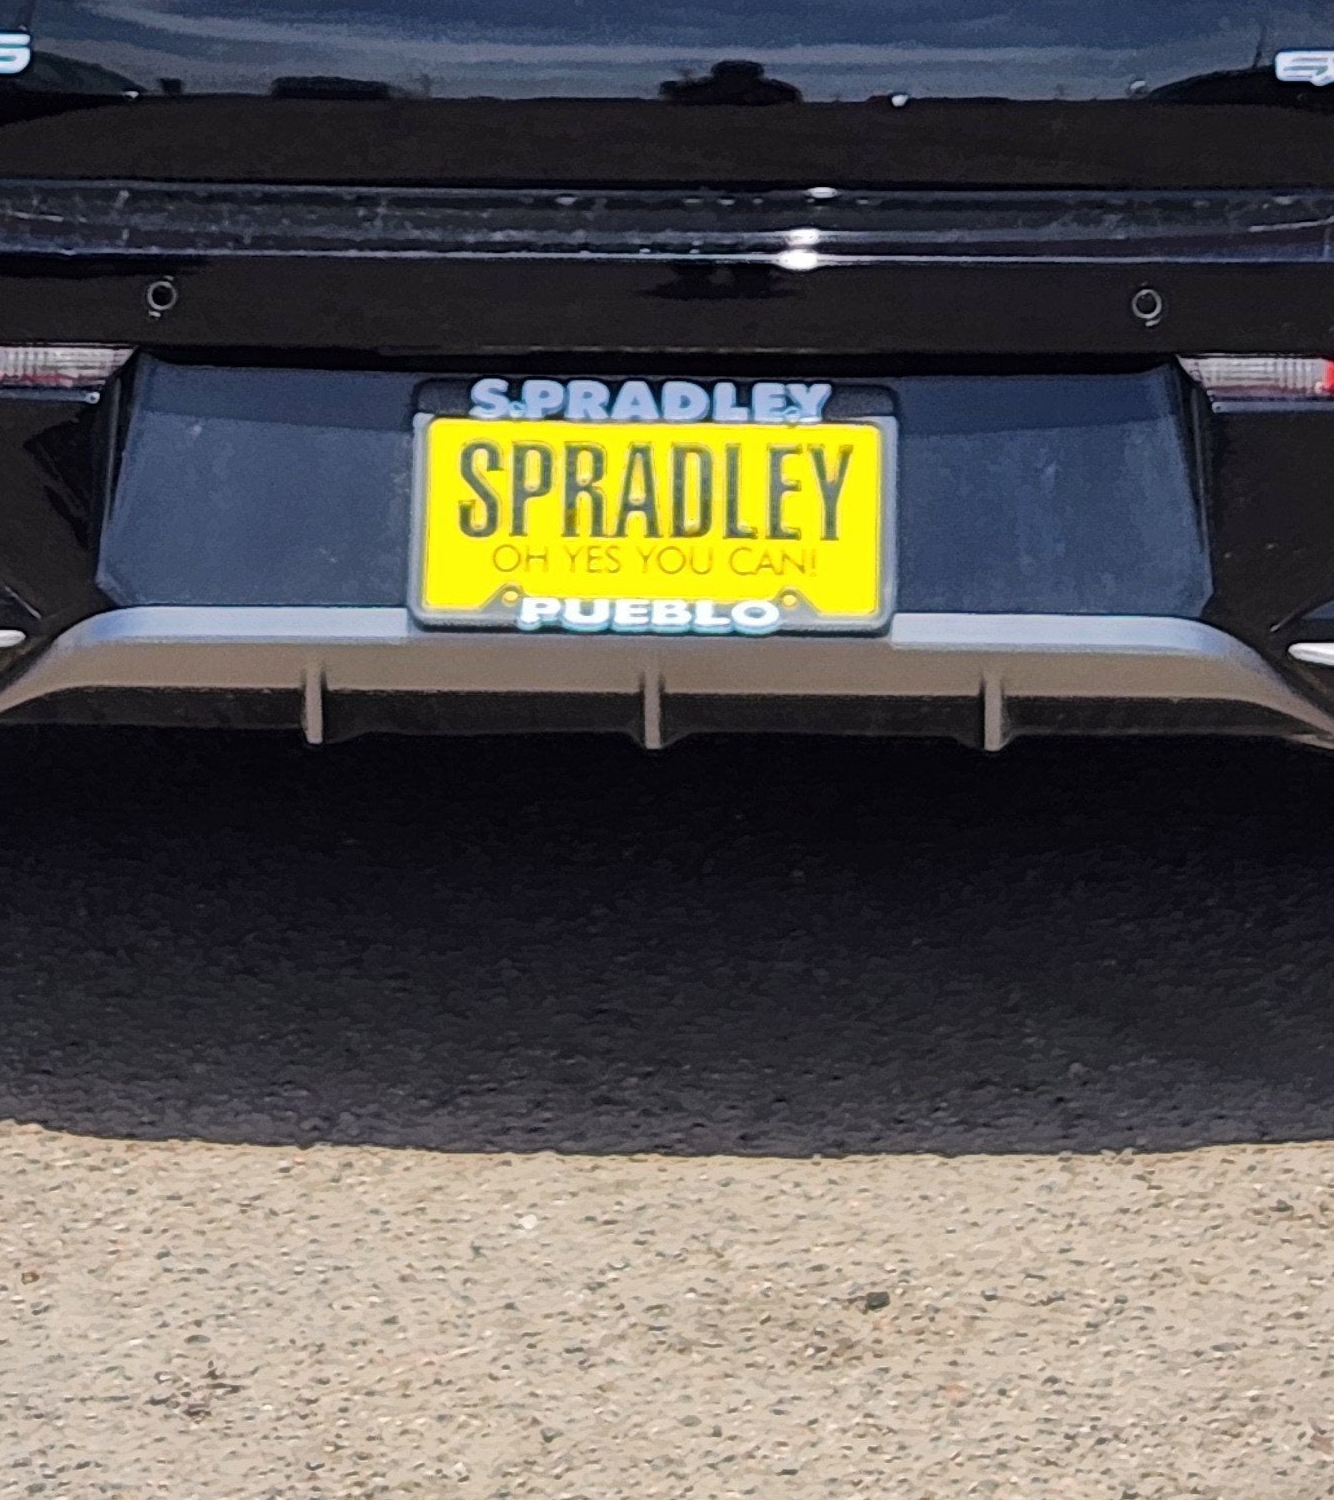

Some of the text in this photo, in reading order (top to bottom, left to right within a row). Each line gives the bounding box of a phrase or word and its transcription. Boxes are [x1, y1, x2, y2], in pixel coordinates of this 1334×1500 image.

[458, 440, 854, 541] SPRADLEY
[492, 543, 818, 578] OH YES YOU CAN!
[517, 596, 781, 633] PUEBLO
